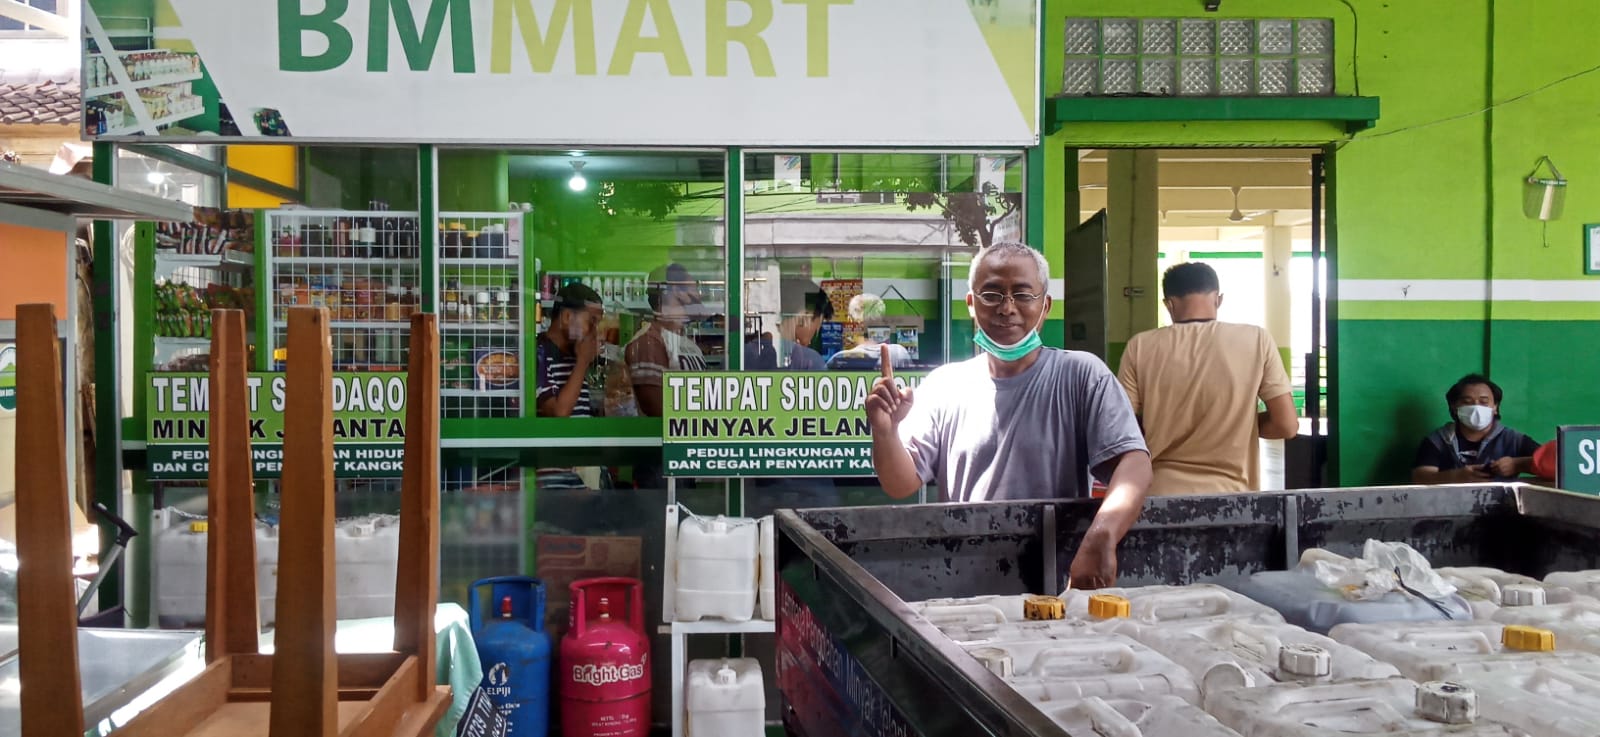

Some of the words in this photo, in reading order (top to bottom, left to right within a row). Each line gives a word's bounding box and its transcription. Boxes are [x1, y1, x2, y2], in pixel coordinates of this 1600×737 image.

[277, 0, 854, 77] BMMART
[152, 377, 262, 412] TEMT
[271, 376, 406, 413] SDAQO
[669, 377, 772, 411] TEMPAT
[781, 376, 925, 411] SHODA
[153, 419, 266, 438] MINK
[669, 417, 775, 437] MINYAK
[784, 417, 871, 437] JELAN
[686, 447, 744, 458] PEDULI
[748, 447, 855, 458] LINGKUNGAN
[1578, 438, 1600, 475] S
[152, 462, 187, 472] DAN
[344, 461, 404, 471] KANGK
[668, 460, 701, 469] DAN
[706, 460, 760, 469] CEGAH
[765, 459, 845, 469] PENYAKIT
[573, 664, 618, 686] Bright
[618, 664, 643, 681] Gas
[486, 687, 511, 697] ELPIJI
